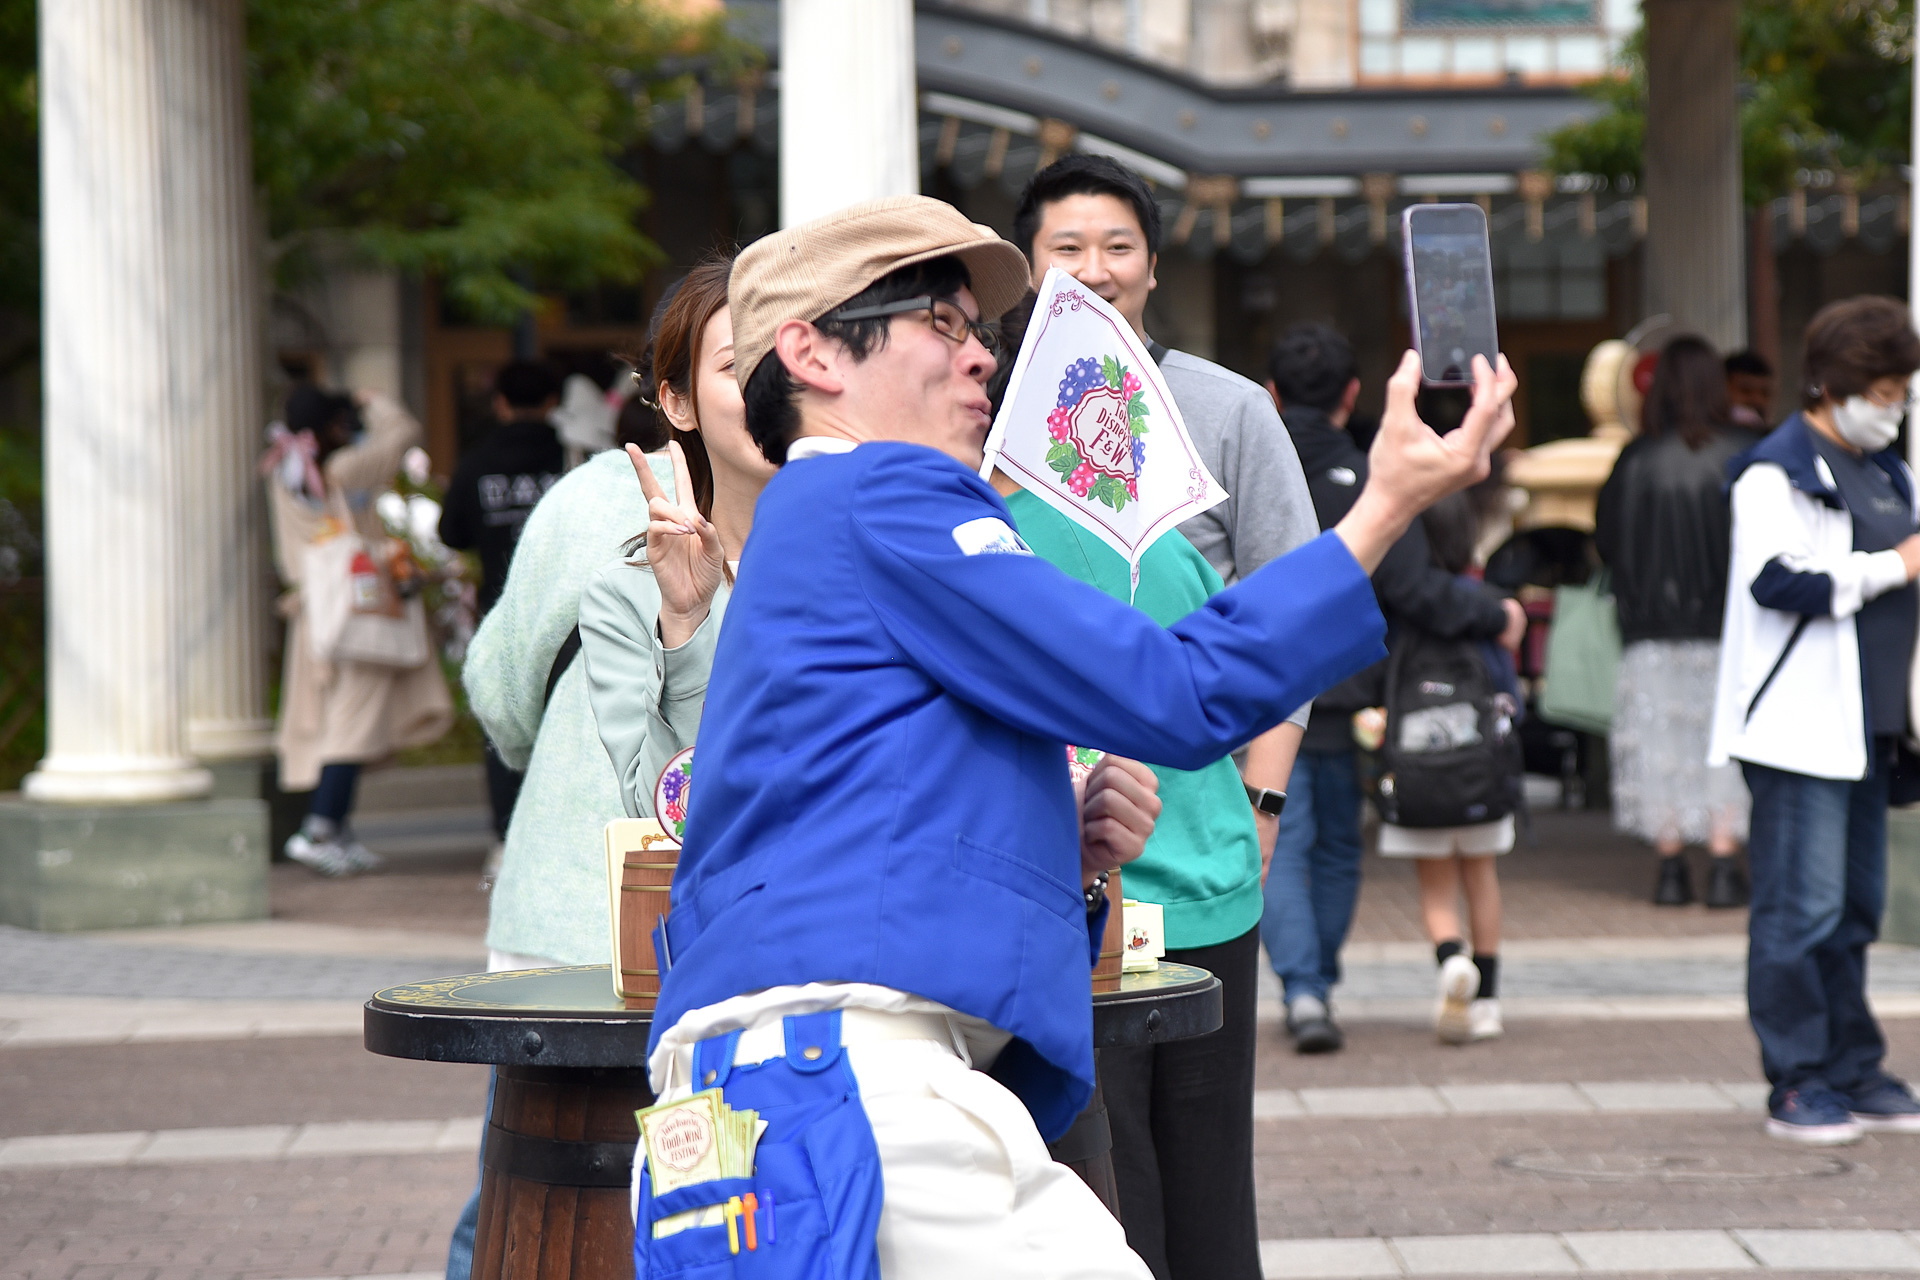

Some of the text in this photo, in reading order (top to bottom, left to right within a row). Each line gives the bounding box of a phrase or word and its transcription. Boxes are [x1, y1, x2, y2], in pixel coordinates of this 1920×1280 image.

[1089, 428, 1128, 467] F&W
[661, 1132, 682, 1151] FOOD
[684, 1126, 703, 1143] WINE
